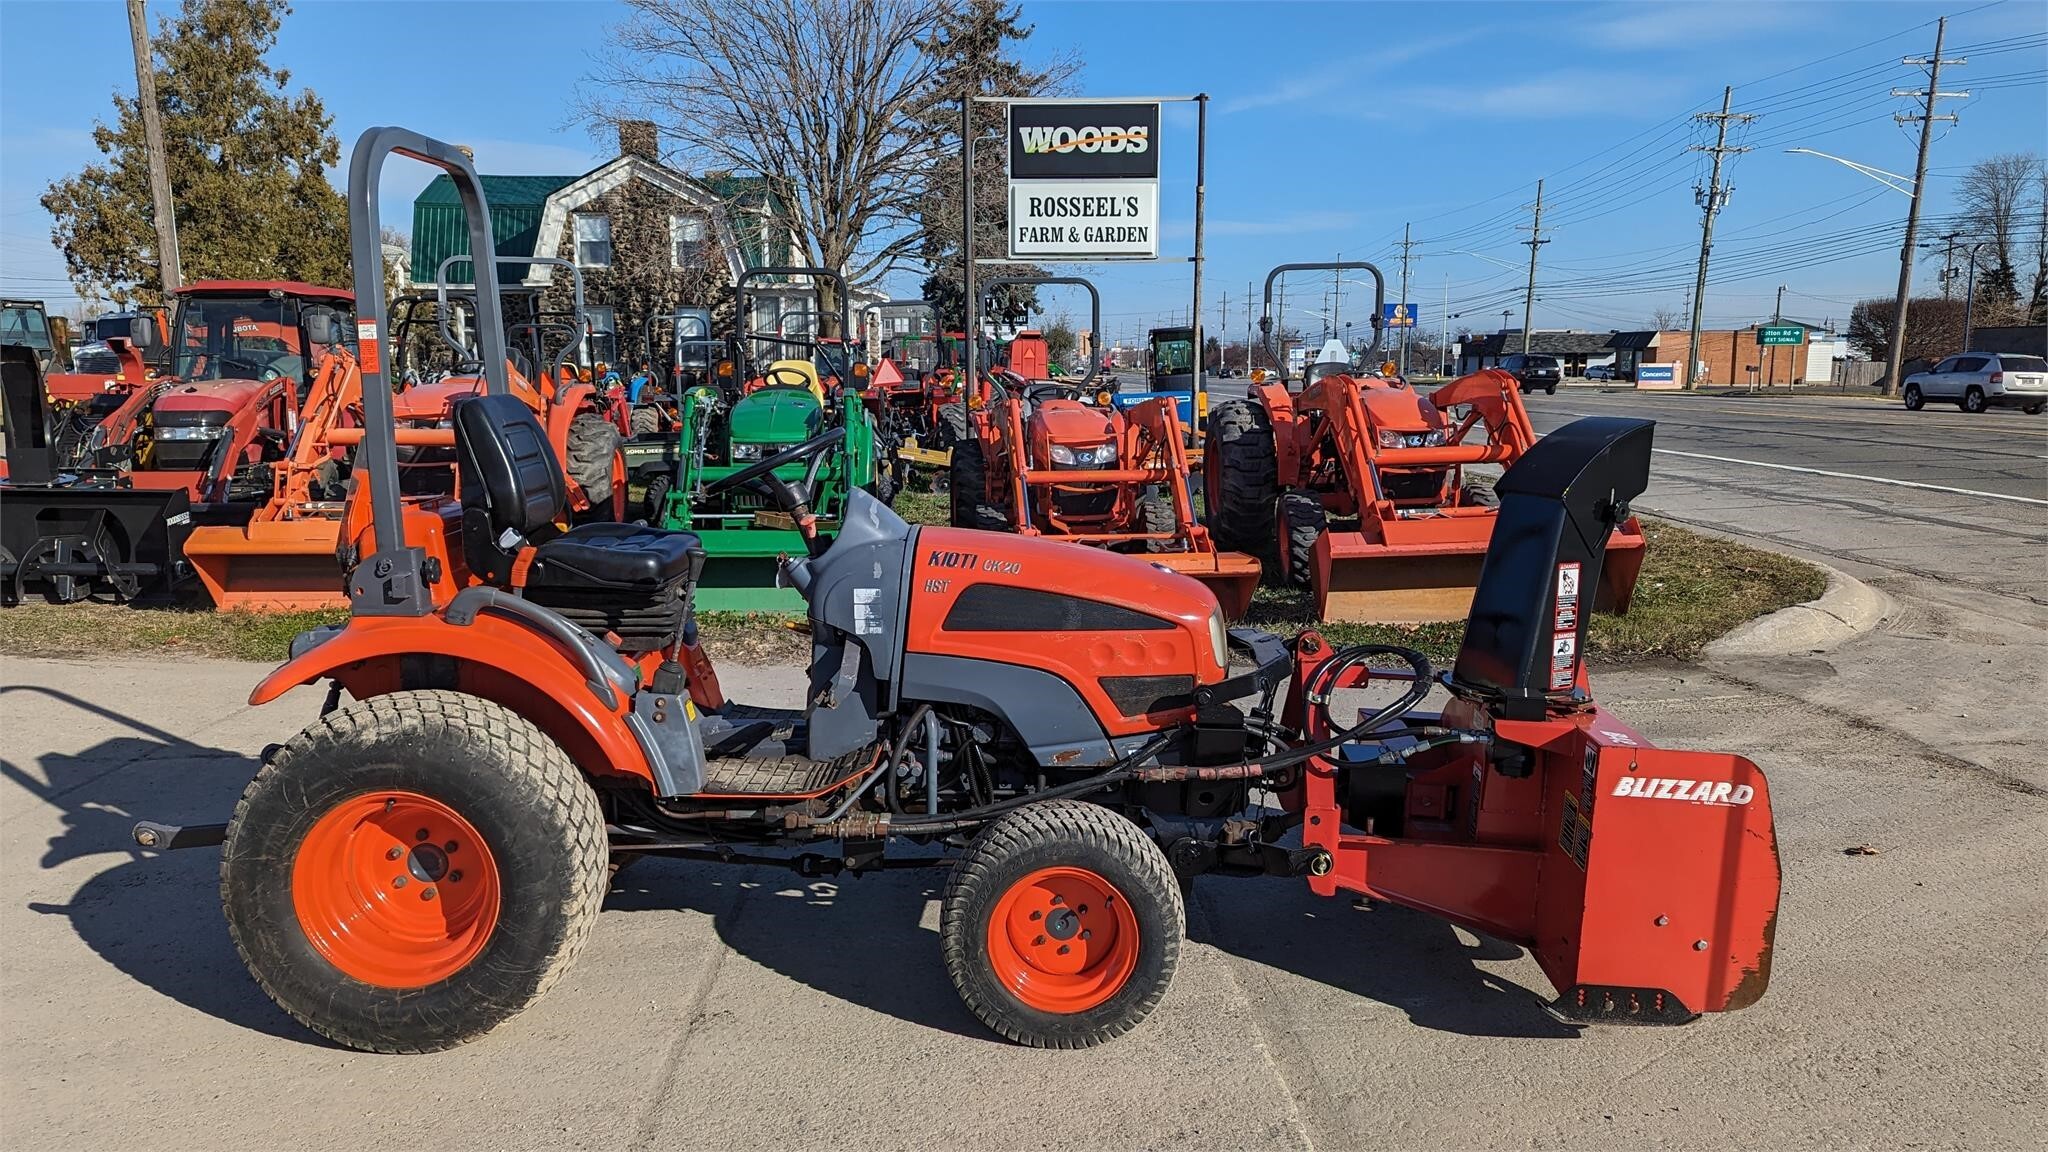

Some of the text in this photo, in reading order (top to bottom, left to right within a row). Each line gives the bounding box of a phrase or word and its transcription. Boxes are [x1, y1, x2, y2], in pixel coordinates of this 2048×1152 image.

[1019, 126, 1148, 153] WOODS
[1029, 196, 1139, 218] ROSSEEL'S
[1019, 226, 1148, 243] FARM & GARDEN
[928, 551, 1022, 575] KIOTI CK20
[925, 579, 951, 593] HST
[1558, 631, 1576, 639] DANGER
[1612, 776, 1754, 805] BLIZZARD
